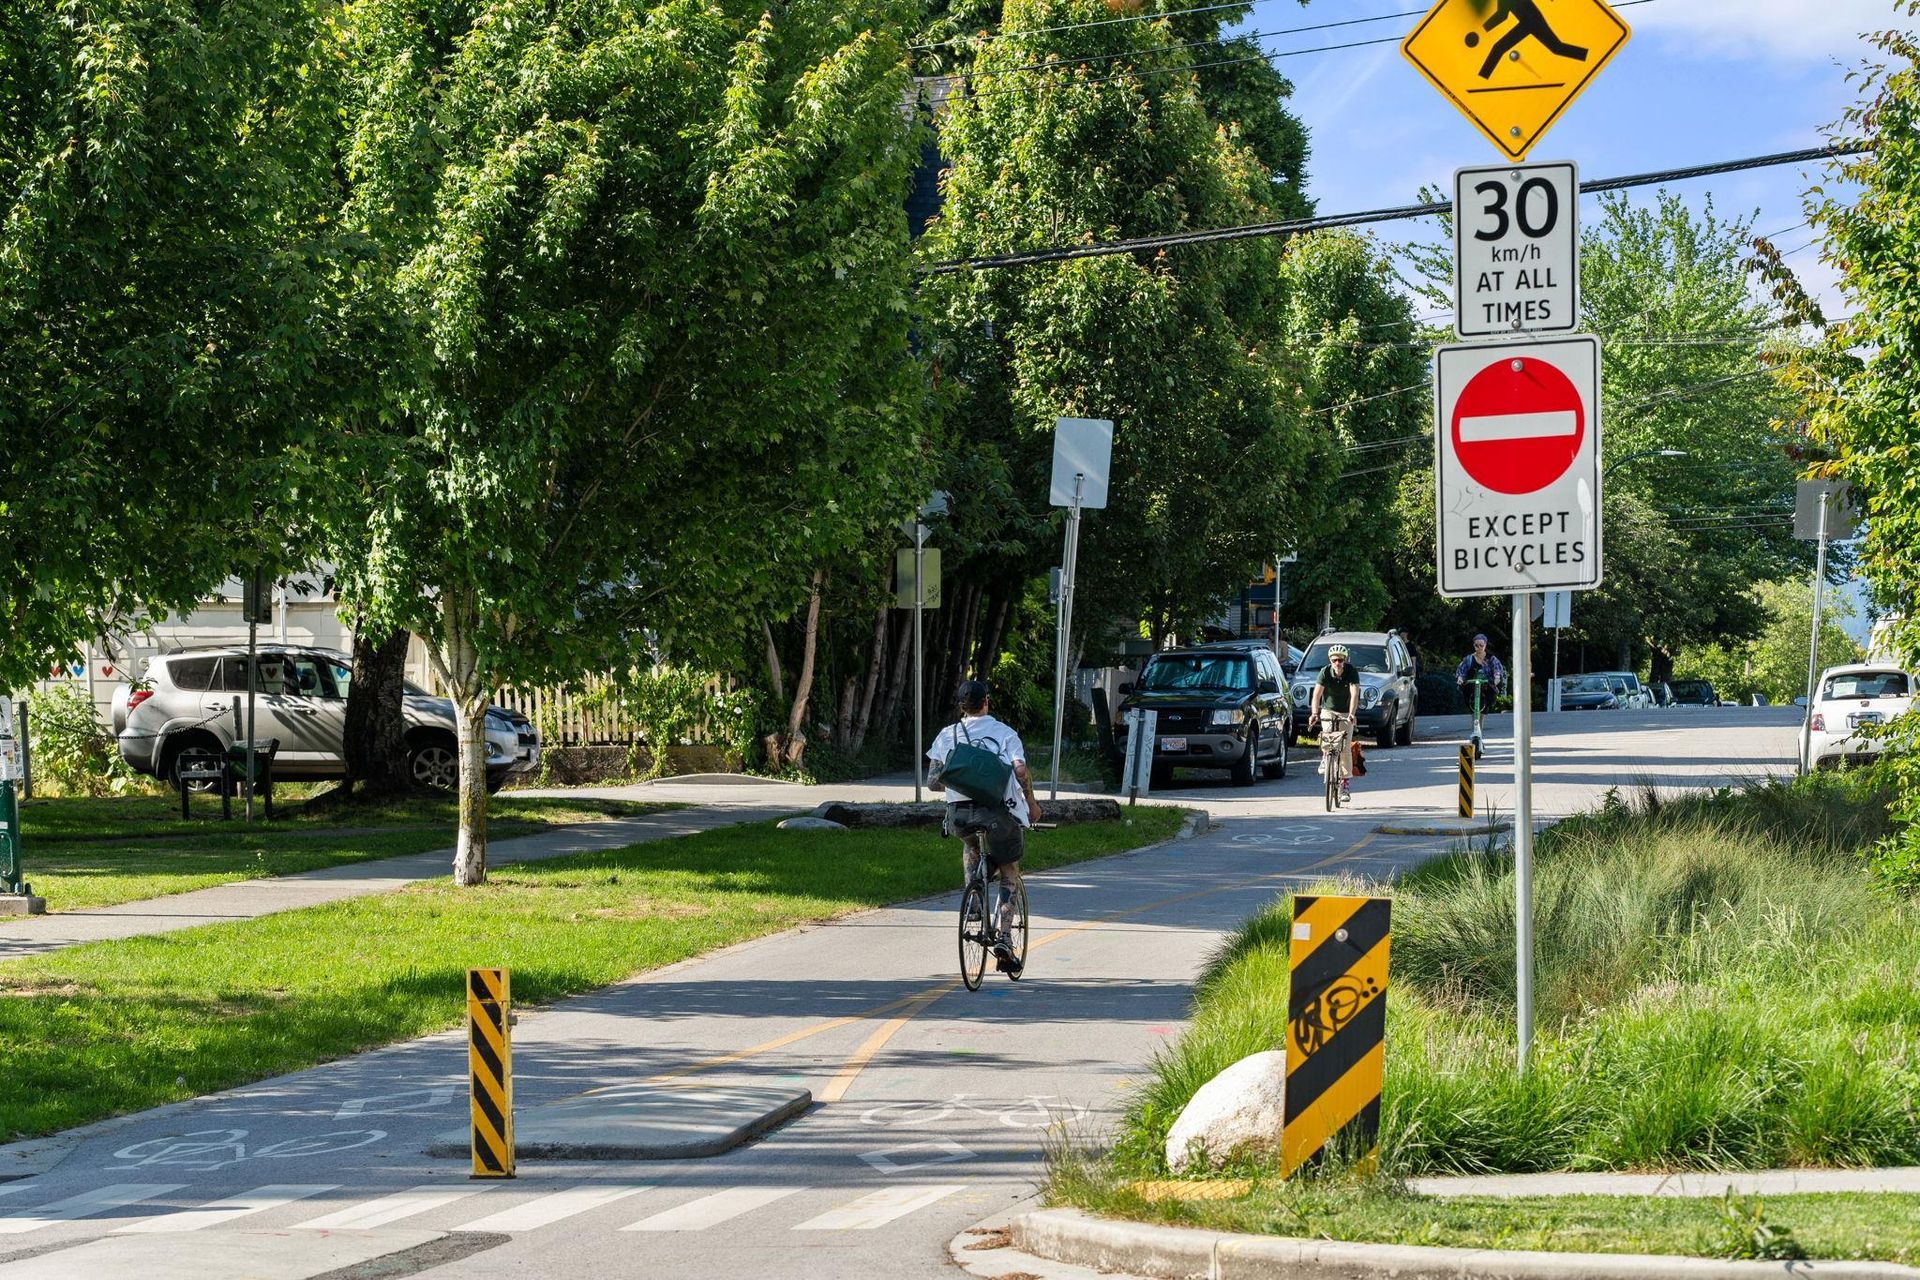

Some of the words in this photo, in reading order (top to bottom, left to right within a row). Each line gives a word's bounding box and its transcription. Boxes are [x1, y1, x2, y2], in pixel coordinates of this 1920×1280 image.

[1474, 177, 1558, 241] 30
[1492, 243, 1541, 263] km/h
[1476, 271, 1504, 293] AT
[1515, 267, 1557, 290] ALL
[1482, 299, 1551, 323] TIMES
[1469, 511, 1570, 539] EXCEPT
[1454, 541, 1585, 570] BICYCLES
